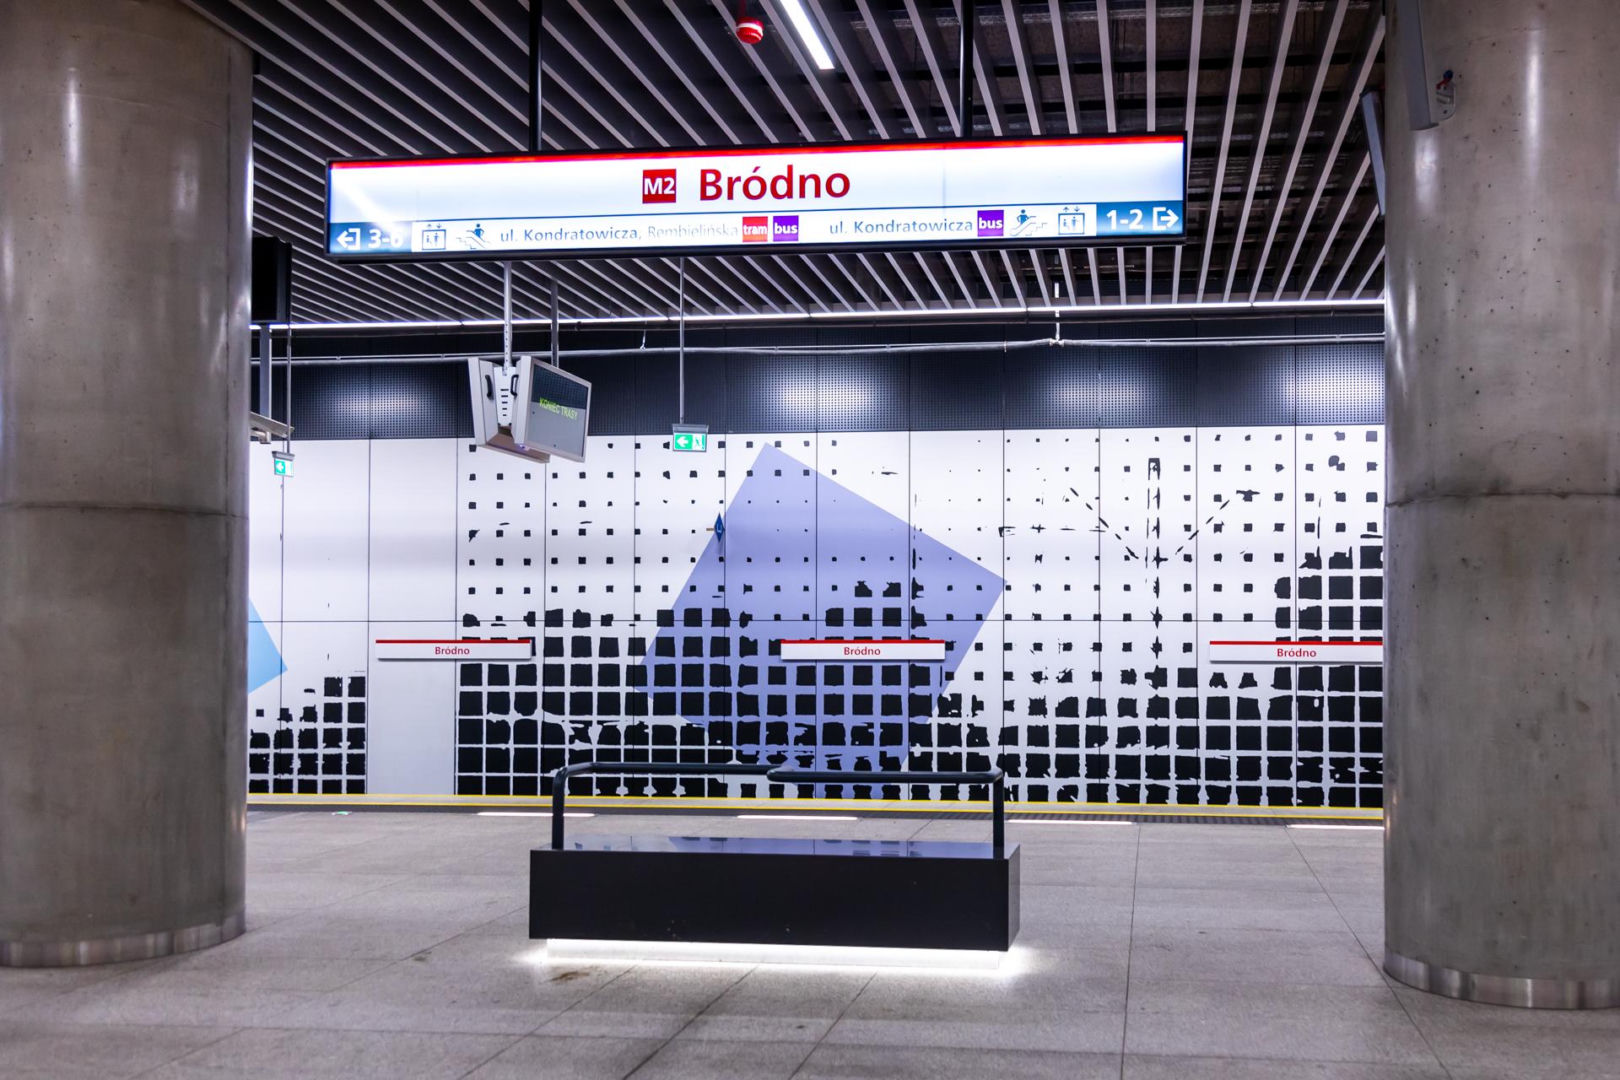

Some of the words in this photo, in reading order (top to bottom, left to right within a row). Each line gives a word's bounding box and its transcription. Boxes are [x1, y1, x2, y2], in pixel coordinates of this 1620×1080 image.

[643, 177, 675, 195] M2
[700, 164, 850, 201] Bródno
[829, 220, 849, 235] ul.
[854, 218, 973, 234] Kondratowicza
[978, 217, 1003, 230] bus
[1106, 208, 1144, 230] 1-2
[500, 228, 518, 242] ul.
[524, 226, 642, 242] Kondratowicza,
[743, 224, 768, 236] tram
[774, 222, 799, 235] bus
[435, 645, 471, 655] Bródno
[843, 645, 881, 656] Bródno
[1276, 647, 1318, 658] Bródno
